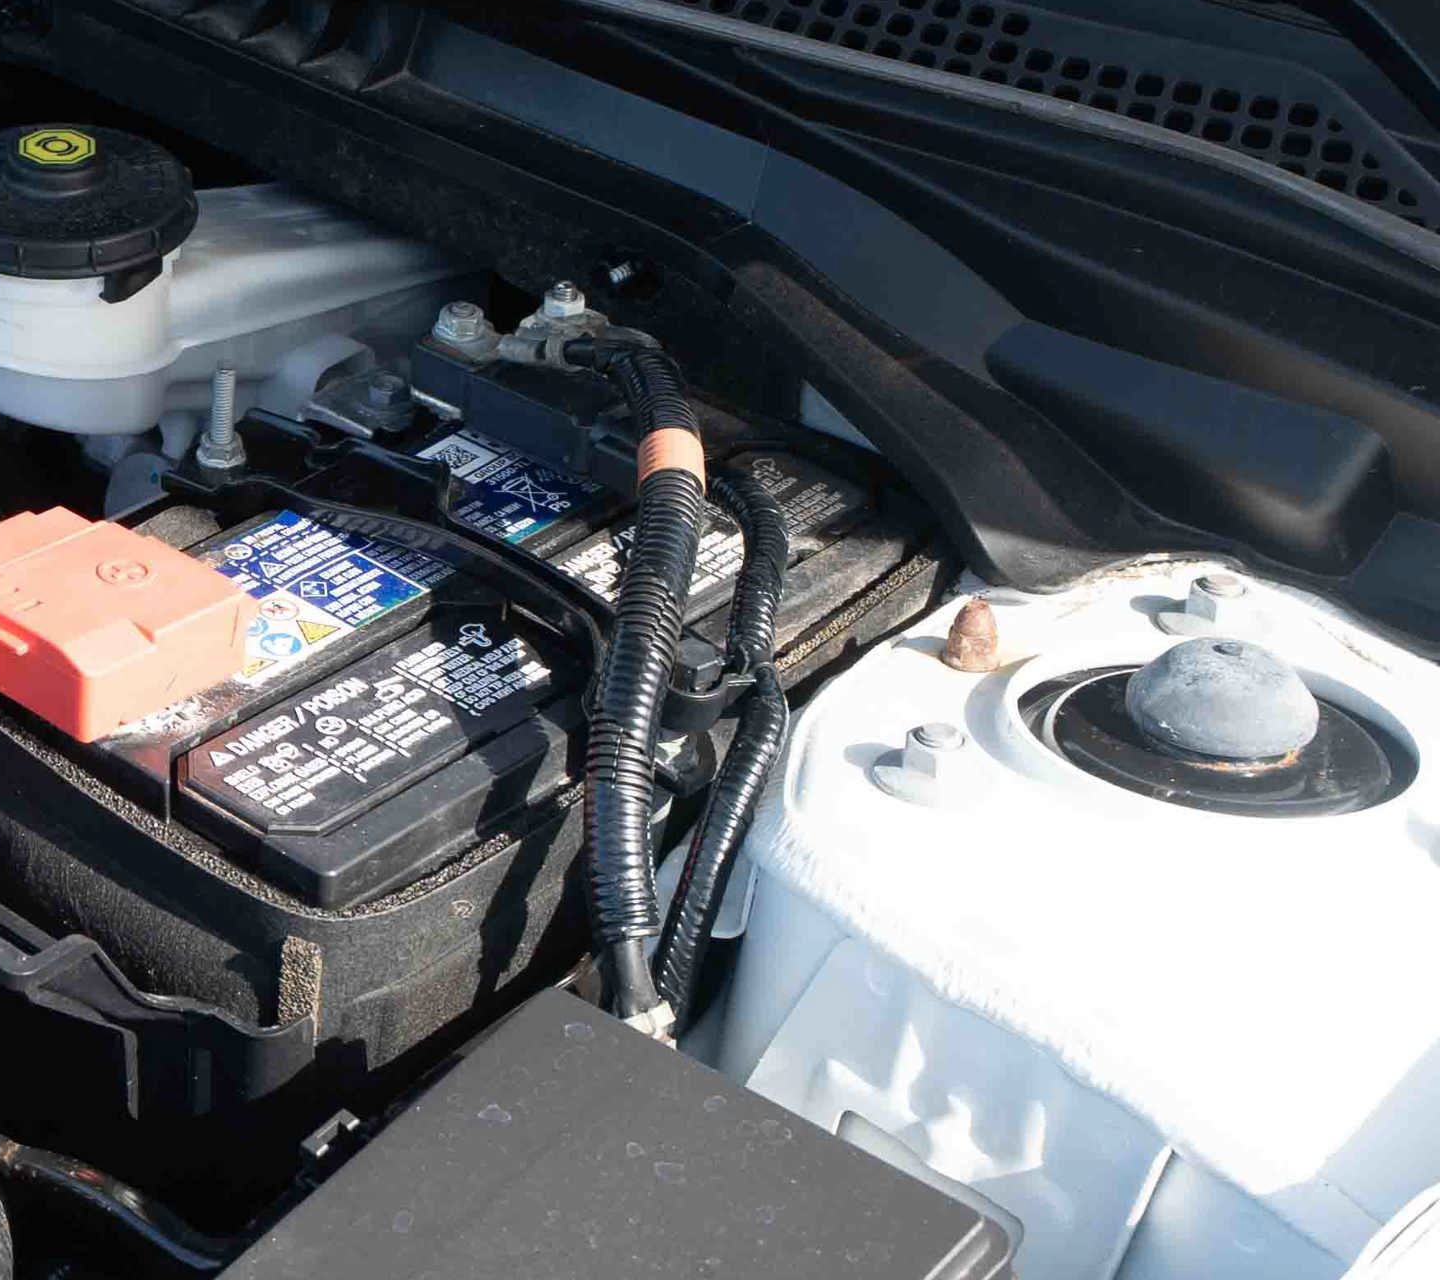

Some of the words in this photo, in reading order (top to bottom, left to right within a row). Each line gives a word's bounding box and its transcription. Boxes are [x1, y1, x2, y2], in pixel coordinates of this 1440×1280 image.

[547, 500, 571, 513] Pb
[225, 715, 300, 756] DANGER
[302, 677, 369, 715] POISON
